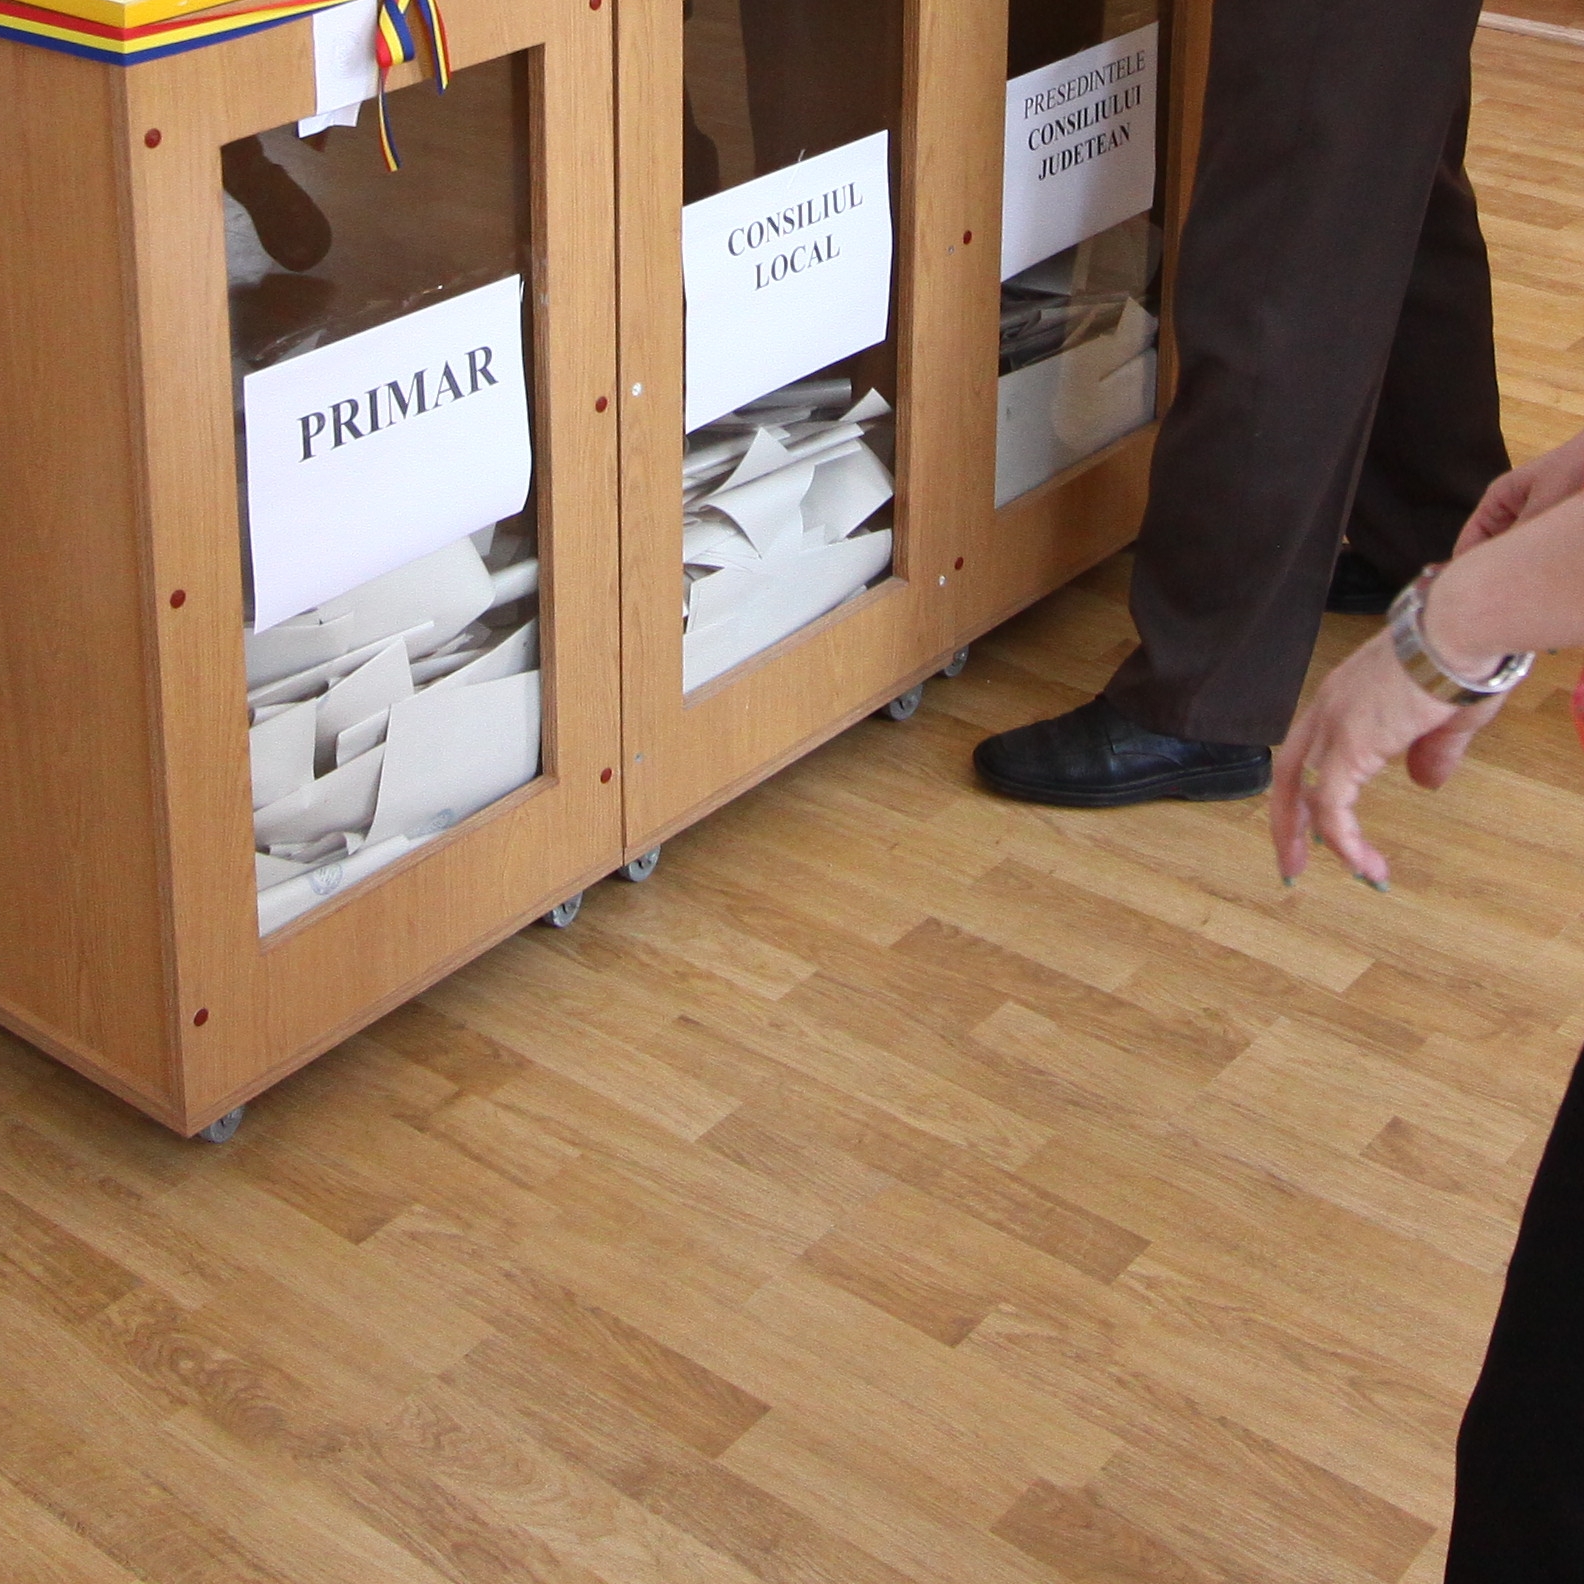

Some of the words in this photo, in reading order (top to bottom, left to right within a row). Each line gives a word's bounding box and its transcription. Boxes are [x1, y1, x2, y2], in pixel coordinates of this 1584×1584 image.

[1023, 49, 1147, 120] PRESEDINTELE
[1027, 84, 1143, 152] CONSILIULUI
[1038, 121, 1132, 182] JUDETEAN
[727, 181, 864, 257] CONSILIUL
[754, 233, 842, 291] LOCAL
[298, 345, 499, 463] PRIMAR
